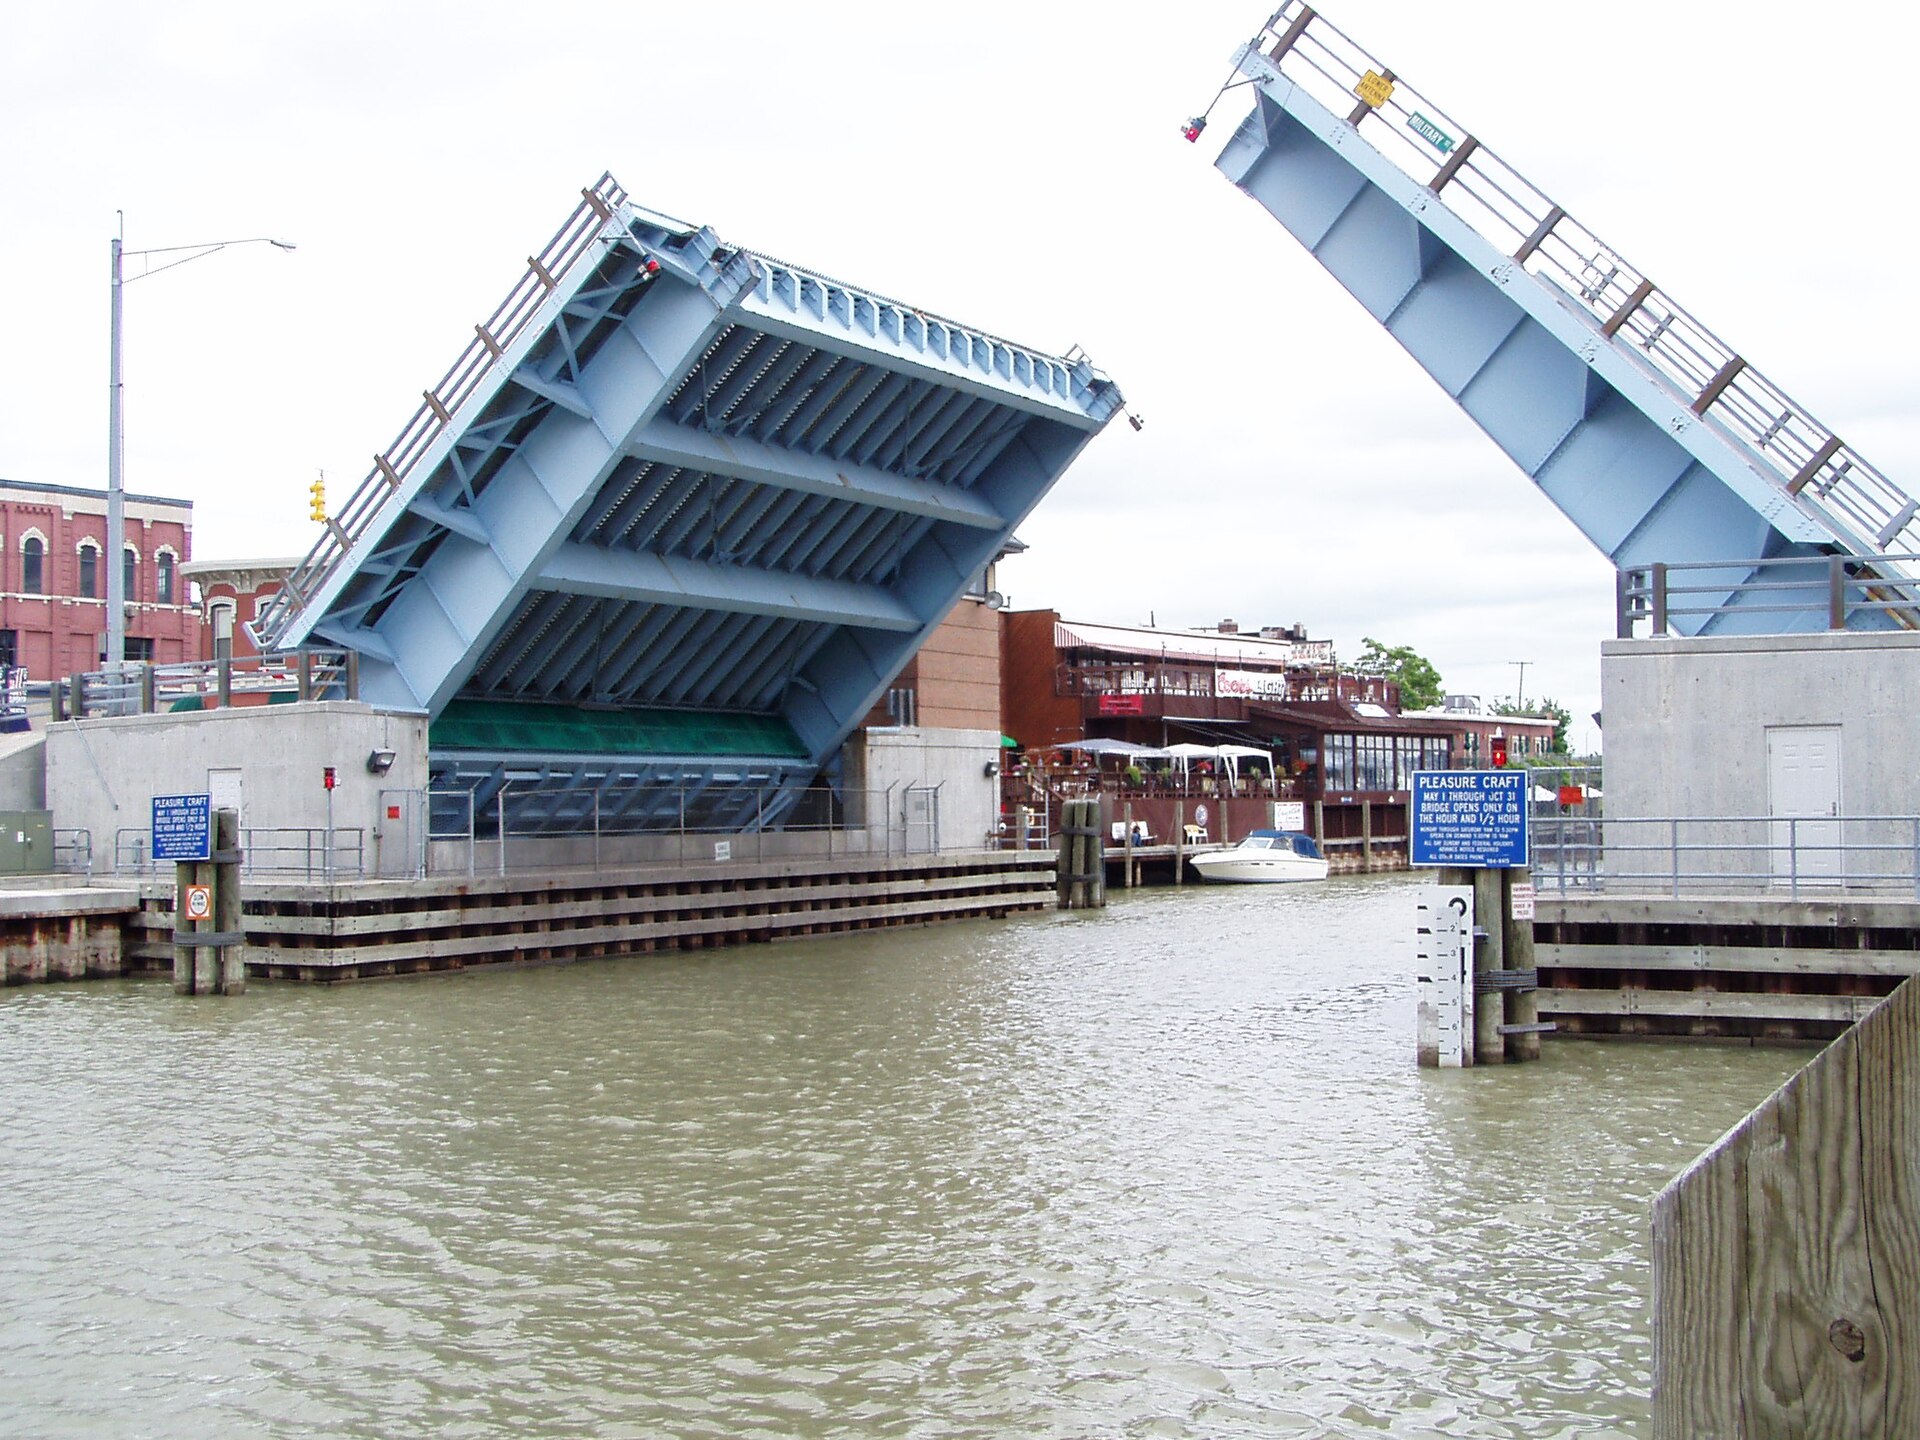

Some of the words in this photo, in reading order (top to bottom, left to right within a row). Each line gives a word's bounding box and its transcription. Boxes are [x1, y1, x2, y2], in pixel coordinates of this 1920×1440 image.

[1408, 114, 1445, 146] MILITARY
[1419, 776, 1477, 789] PLEASURE
[1482, 776, 1520, 789] CRAFT
[1423, 791, 1438, 801] MAY
[1442, 791, 1446, 801] 1
[1449, 791, 1485, 801] THROUGH
[1507, 791, 1516, 801] 31
[154, 798, 185, 808] PLEASURE
[187, 797, 207, 806] CRAFT
[1421, 802, 1449, 813] BRIDGE
[1453, 802, 1479, 813] OPENS
[1483, 802, 1503, 813] ONLY
[1506, 802, 1518, 813] ON
[1419, 814, 1433, 823] THE
[1436, 814, 1458, 823] HOUR
[1460, 814, 1476, 823] AND
[1479, 813, 1495, 825] 1/2
[1497, 814, 1520, 824] HOUR
